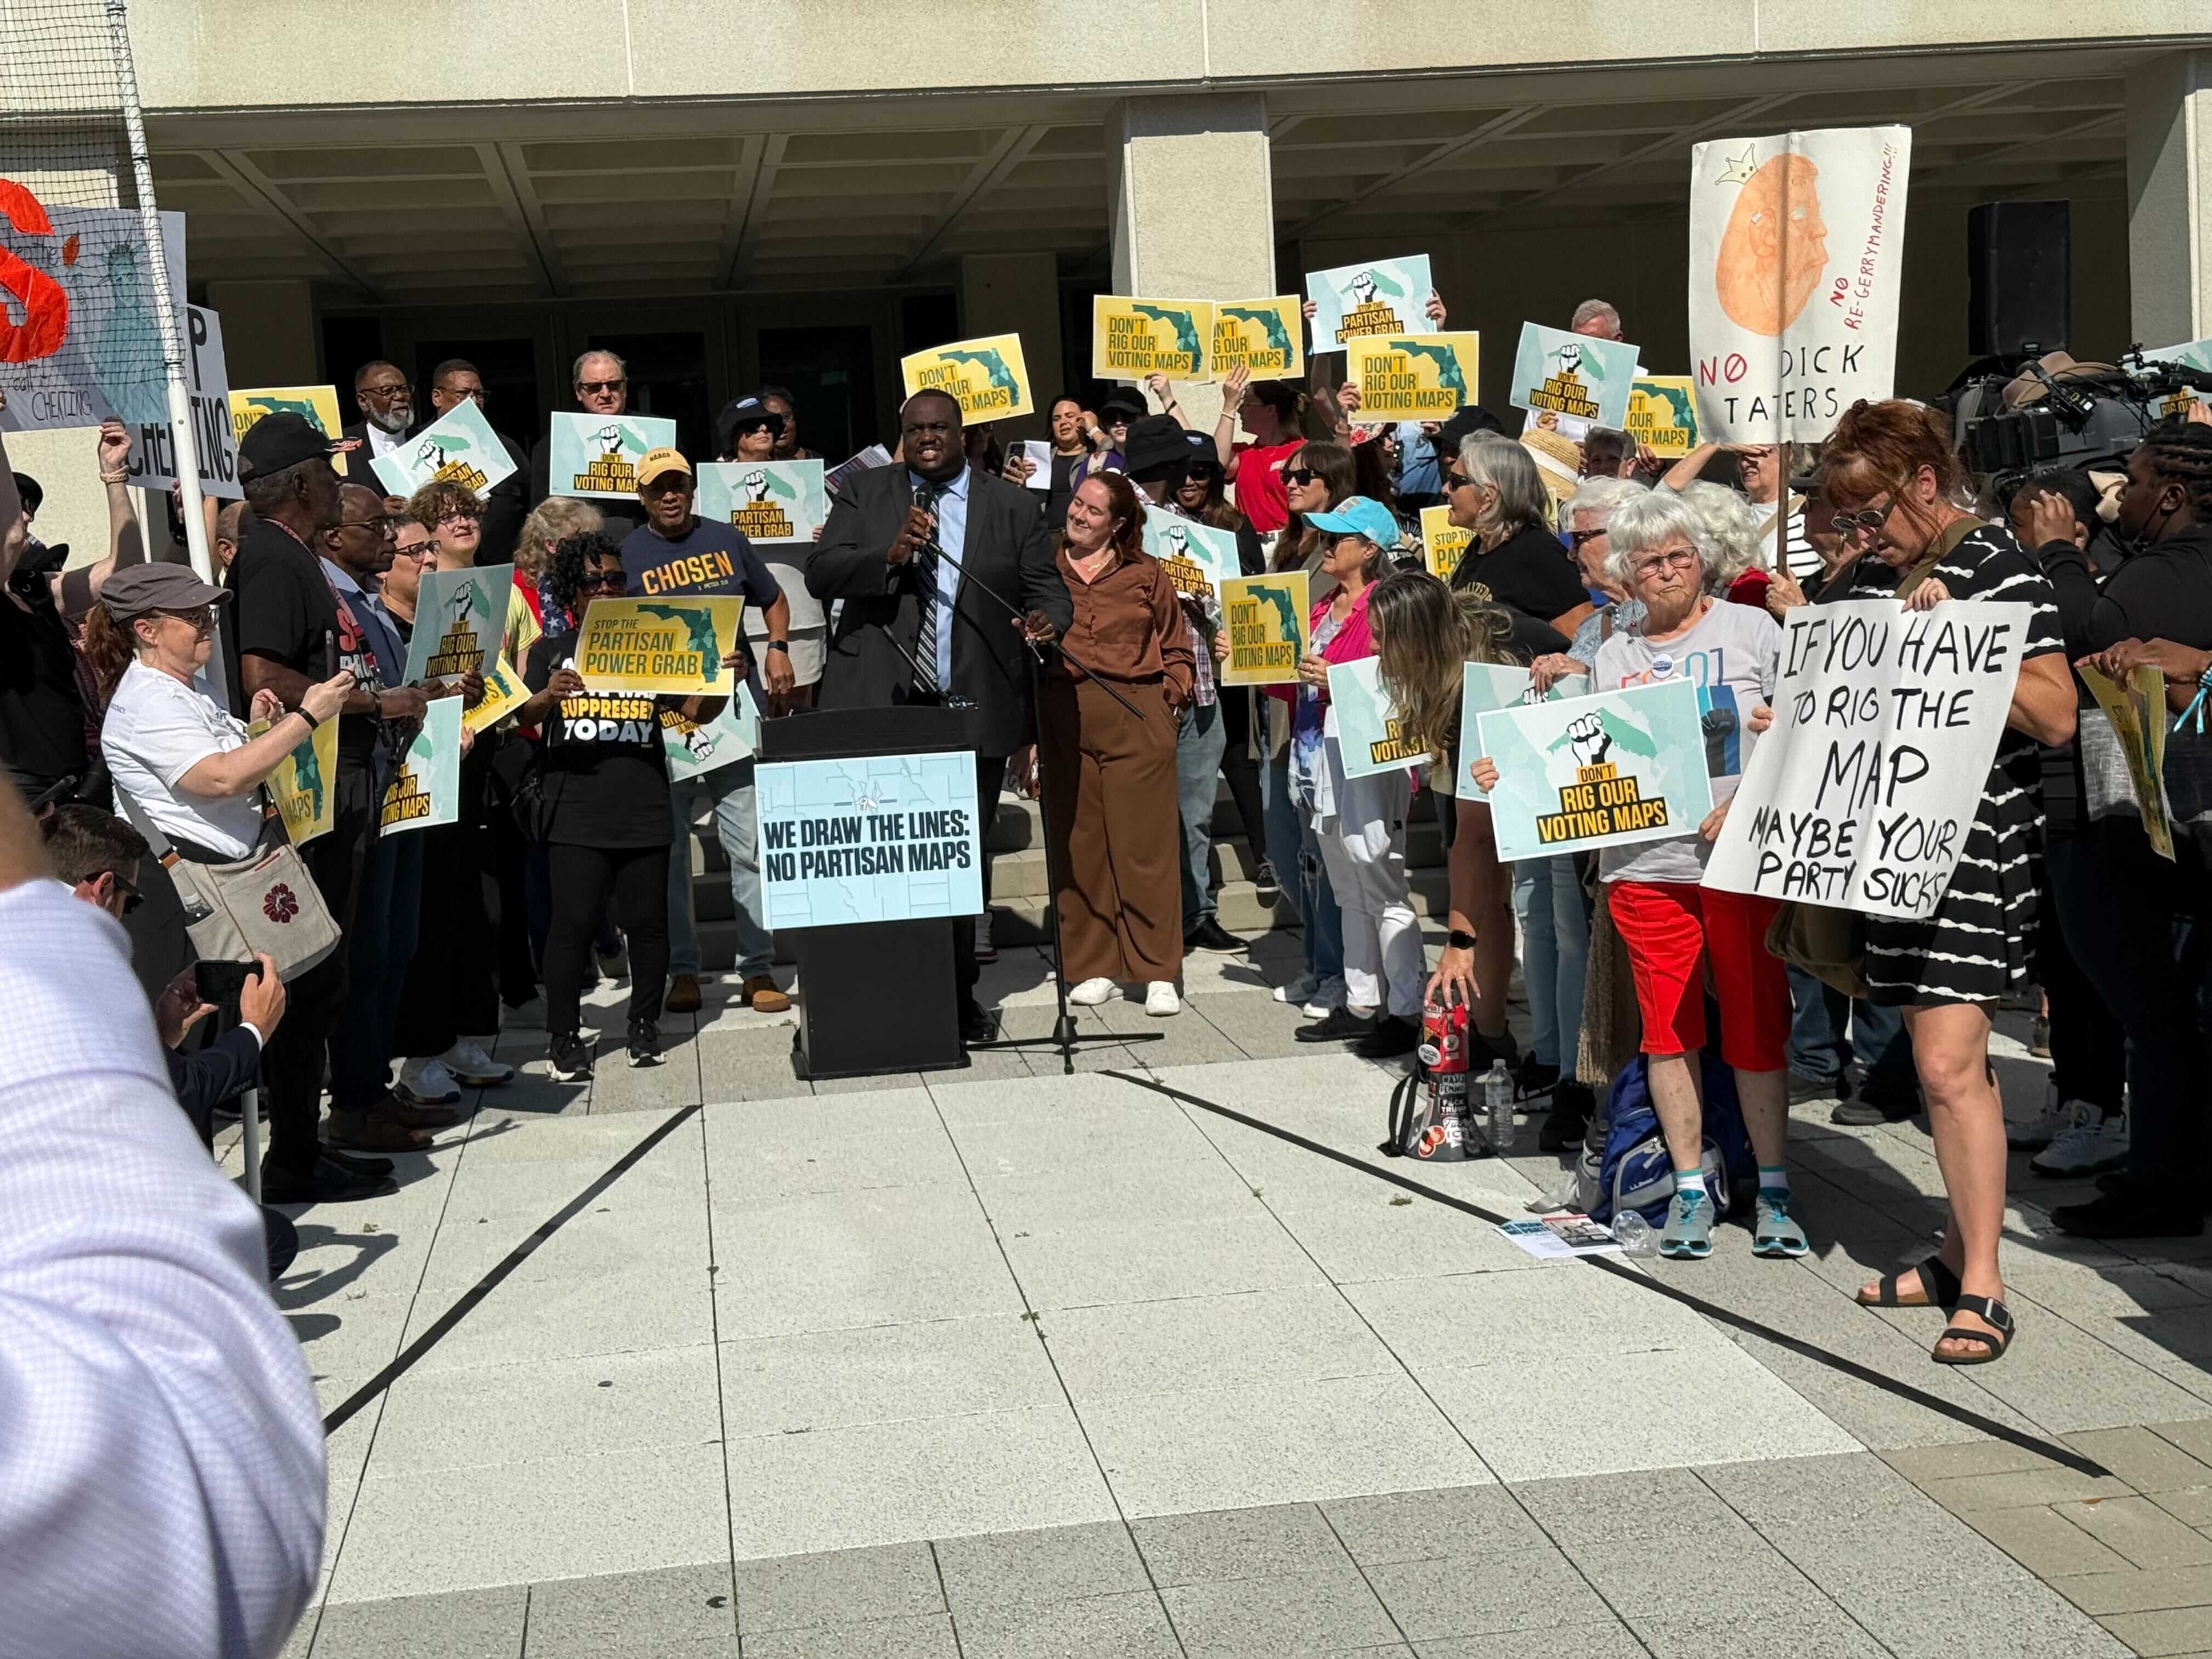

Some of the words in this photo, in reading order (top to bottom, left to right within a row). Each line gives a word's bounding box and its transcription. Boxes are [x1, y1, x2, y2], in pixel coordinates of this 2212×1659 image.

[1109, 317, 1147, 335] DON'T
[1343, 309, 1393, 329] PARTISAN
[1109, 334, 1128, 350] RIG
[1132, 335, 1155, 352] OUR
[1223, 337, 1248, 353] OUR
[1108, 351, 1151, 368] VOTING
[1154, 353, 1189, 369] MAPS
[1211, 354, 1245, 371] OTING
[1248, 351, 1281, 368] MAPS
[1364, 356, 1406, 374] DON'T
[1781, 345, 1865, 379] DICK
[918, 364, 956, 387] DON'T
[1365, 374, 1386, 391] RIG
[1390, 373, 1417, 391] OUR
[944, 379, 970, 396] OUR
[1544, 380, 1563, 396] RIG
[1564, 383, 1585, 400] OUR
[32, 390, 92, 421] CHEATING
[972, 389, 1008, 410] MAPS
[1364, 391, 1412, 409] VOTING
[1415, 391, 1453, 408] MAPS
[1531, 390, 1566, 411] VOTING
[1567, 399, 1598, 417] MAPS
[1724, 387, 1838, 424] TATERS
[233, 413, 264, 431] ON'
[1629, 412, 1653, 428] OUR
[127, 396, 235, 483] HEING
[1652, 429, 1685, 445] MAPS
[602, 454, 621, 462] DON'T
[590, 462, 608, 477] RIG
[610, 463, 632, 478] OUR
[464, 472, 486, 491] RAB
[575, 476, 614, 491] VOTING
[616, 478, 639, 492] MAP
[732, 510, 783, 524] PARTISAN
[735, 524, 761, 537] WER
[764, 523, 792, 537] GRAB
[1435, 532, 1457, 545] STOP
[641, 550, 735, 595] CHOSEN
[1159, 558, 1204, 583] PARTISAN
[594, 619, 619, 630] STOP
[621, 618, 640, 629] THE
[1231, 603, 1257, 624] DON'T
[440, 635, 455, 655] RIG
[456, 634, 476, 653] OUR
[588, 631, 675, 651] PARTISAN
[1232, 625, 1246, 646] RIG
[1248, 624, 1265, 645] OUR
[1233, 646, 1263, 668] VOTING
[1265, 645, 1291, 666] MAPS
[1784, 619, 1826, 679] IF
[1824, 616, 1889, 674] YOU
[1898, 618, 2010, 676] HAVE
[427, 654, 457, 678] VOTING
[585, 652, 648, 674] POWER
[652, 654, 698, 676] GRAB
[1791, 689, 1816, 729] TO
[1825, 686, 1880, 730] RIG
[1891, 687, 1974, 730] THE
[1579, 764, 1613, 783] DON'T
[1815, 740, 1929, 819] MAP
[1561, 785, 1595, 813] RIG
[1599, 778, 1638, 806] OUR
[400, 795, 429, 820] MAPS
[763, 820, 797, 850] WE
[800, 816, 863, 848] DRAW
[867, 813, 904, 842] THE
[909, 809, 970, 840] LINES:
[1538, 811, 1610, 843] VOTING
[1615, 800, 1667, 832] MAPS
[1748, 805, 1858, 859] MAYBE
[1877, 812, 1957, 864] YOUR
[766, 852, 797, 883] NO
[800, 844, 904, 880] PARTISAN
[908, 840, 972, 872] MAPS
[1754, 850, 1858, 901] PARTY
[1865, 867, 1948, 914] SUCKS
